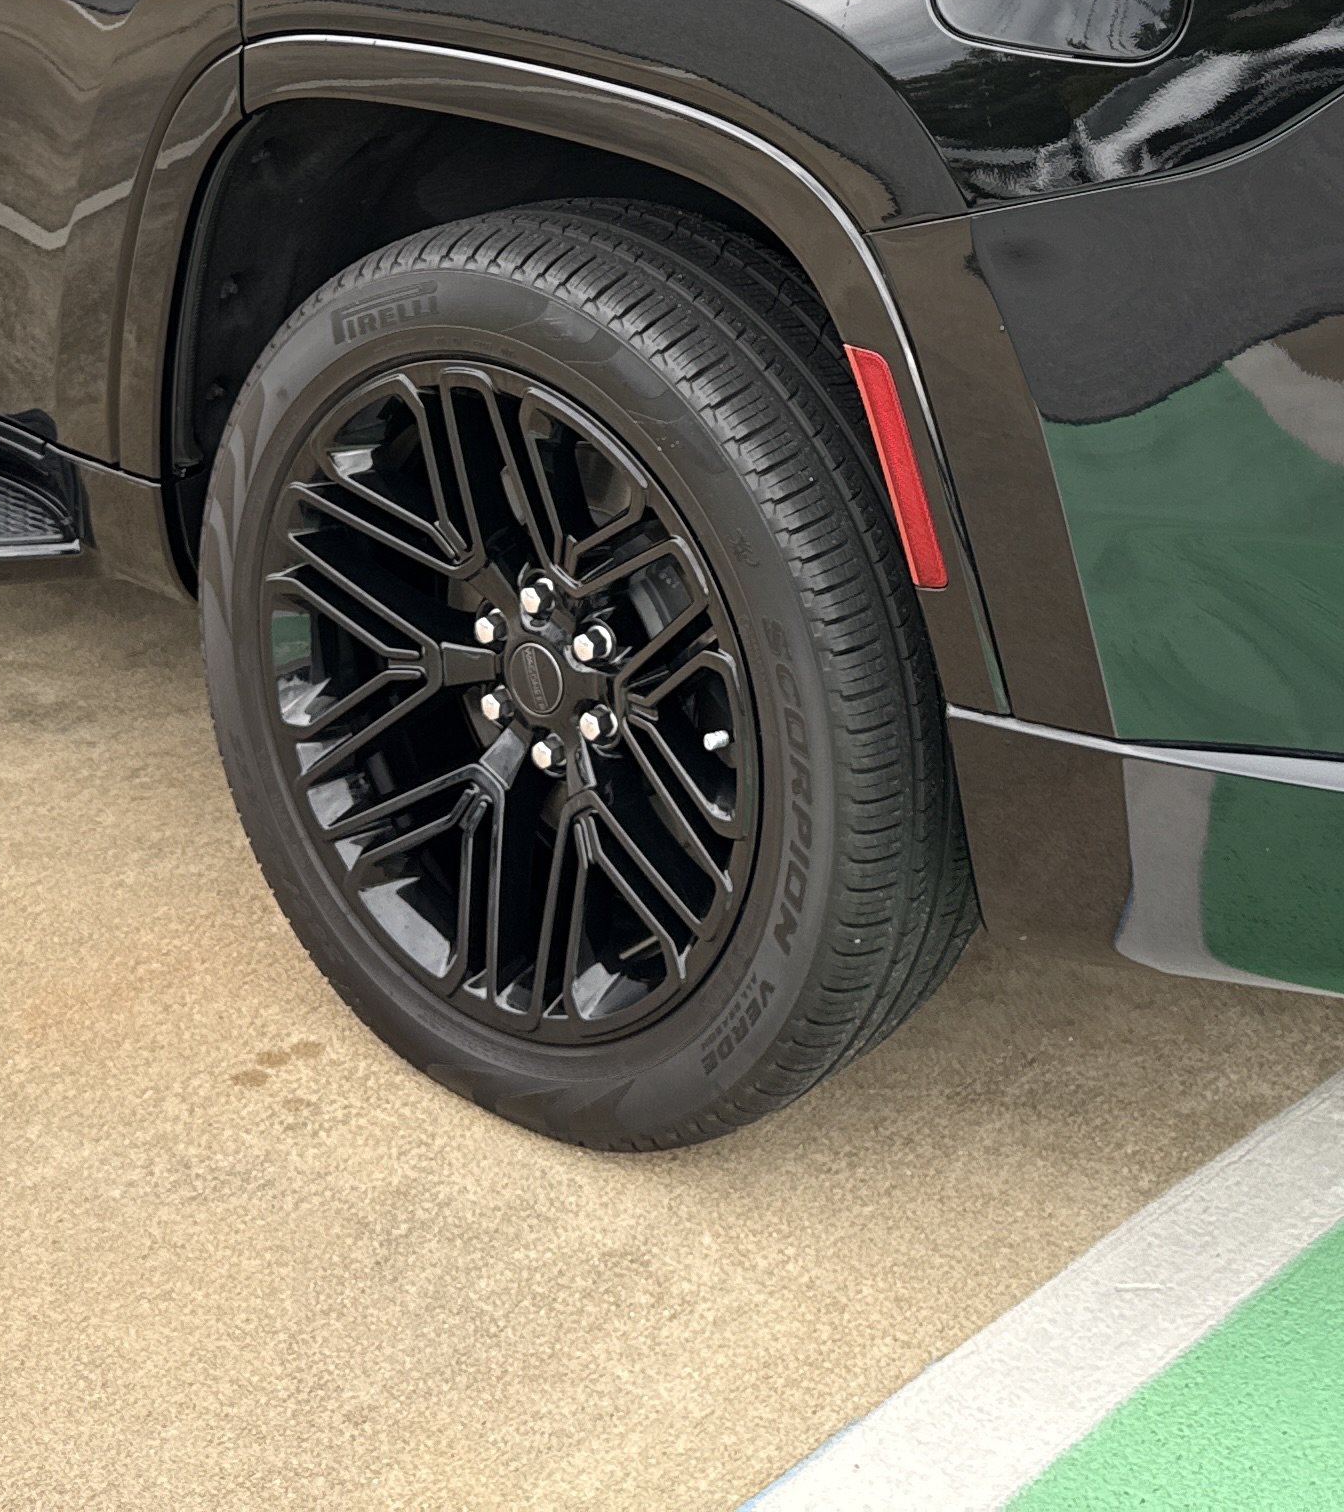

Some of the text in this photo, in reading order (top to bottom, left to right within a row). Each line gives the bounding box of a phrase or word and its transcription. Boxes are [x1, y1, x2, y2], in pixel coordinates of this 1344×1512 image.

[330, 279, 439, 346] PIRELLI
[700, 615, 814, 1076] SCORPION VERDE
